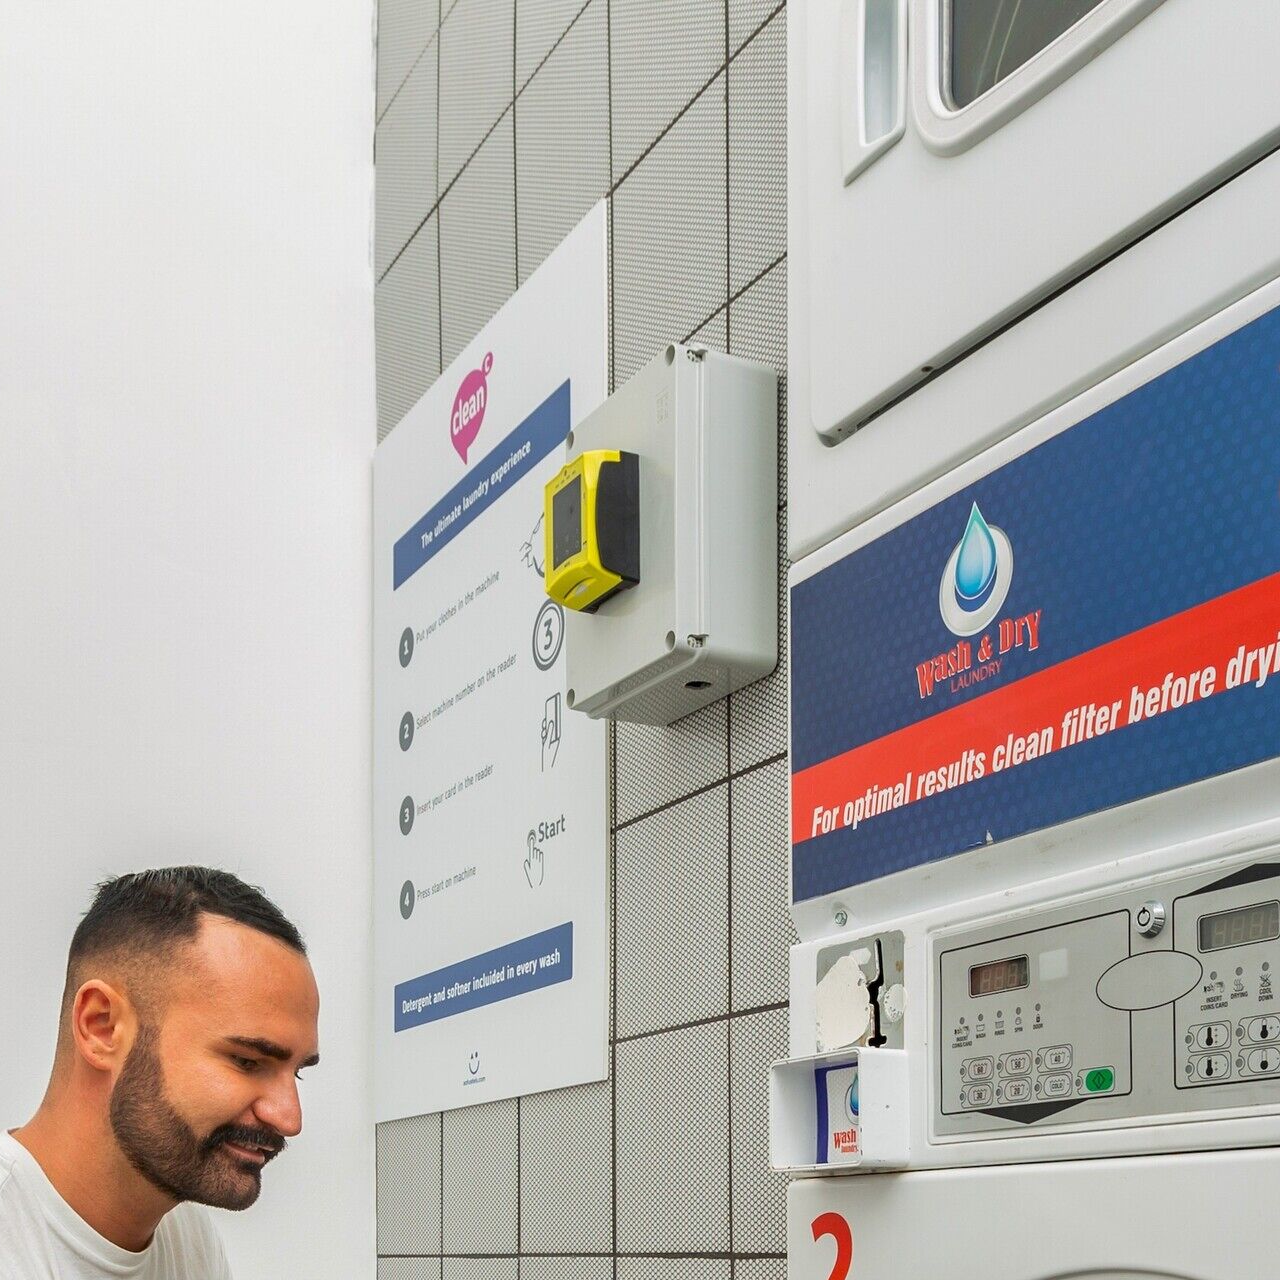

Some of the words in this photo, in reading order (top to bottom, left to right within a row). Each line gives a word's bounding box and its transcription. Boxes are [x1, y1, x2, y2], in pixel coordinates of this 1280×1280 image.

[452, 386, 484, 435] clean
[421, 531, 433, 548] The
[434, 504, 461, 537] ultimate
[462, 479, 489, 511] laundry
[490, 441, 531, 485] experience
[403, 639, 410, 655] 1
[416, 629, 426, 644] Put
[425, 620, 437, 639] your
[437, 603, 457, 627] clothes
[457, 598, 464, 611] in
[464, 589, 474, 605] the
[475, 571, 500, 596] machine
[543, 617, 553, 650] 3
[916, 640, 971, 699] Wash
[977, 634, 993, 663] &
[950, 659, 1003, 694] LAUNDRY
[403, 723, 410, 739] 2
[416, 711, 431, 730] Select
[432, 697, 454, 719] machine
[454, 681, 476, 703] number
[477, 675, 485, 688] on
[486, 667, 496, 682] the
[497, 653, 517, 674] reader
[811, 805, 840, 838] For
[842, 772, 913, 830] optimal
[916, 748, 987, 801] results
[991, 726, 1055, 773] clean
[1060, 699, 1122, 748] filter
[1127, 664, 1217, 725] before
[404, 807, 410, 823] 3
[416, 800, 431, 816] Insert
[431, 792, 444, 811] your
[444, 782, 457, 800] card
[457, 781, 463, 792] in
[464, 775, 474, 788] the
[475, 764, 493, 782] reader
[538, 814, 566, 843] Start
[404, 891, 410, 907] 4
[416, 888, 431, 901] Press
[431, 879, 444, 895] start
[445, 876, 452, 888] on
[453, 866, 476, 884] machine
[402, 994, 432, 1014] Detergent
[433, 986, 446, 1004] and
[447, 981, 471, 999] softner
[506, 964, 515, 979] in
[516, 958, 537, 976] every
[538, 948, 561, 969] wash
[1206, 995, 1222, 1003] INSERT
[1230, 991, 1248, 999] DRYING
[833, 1128, 857, 1149] Wash
